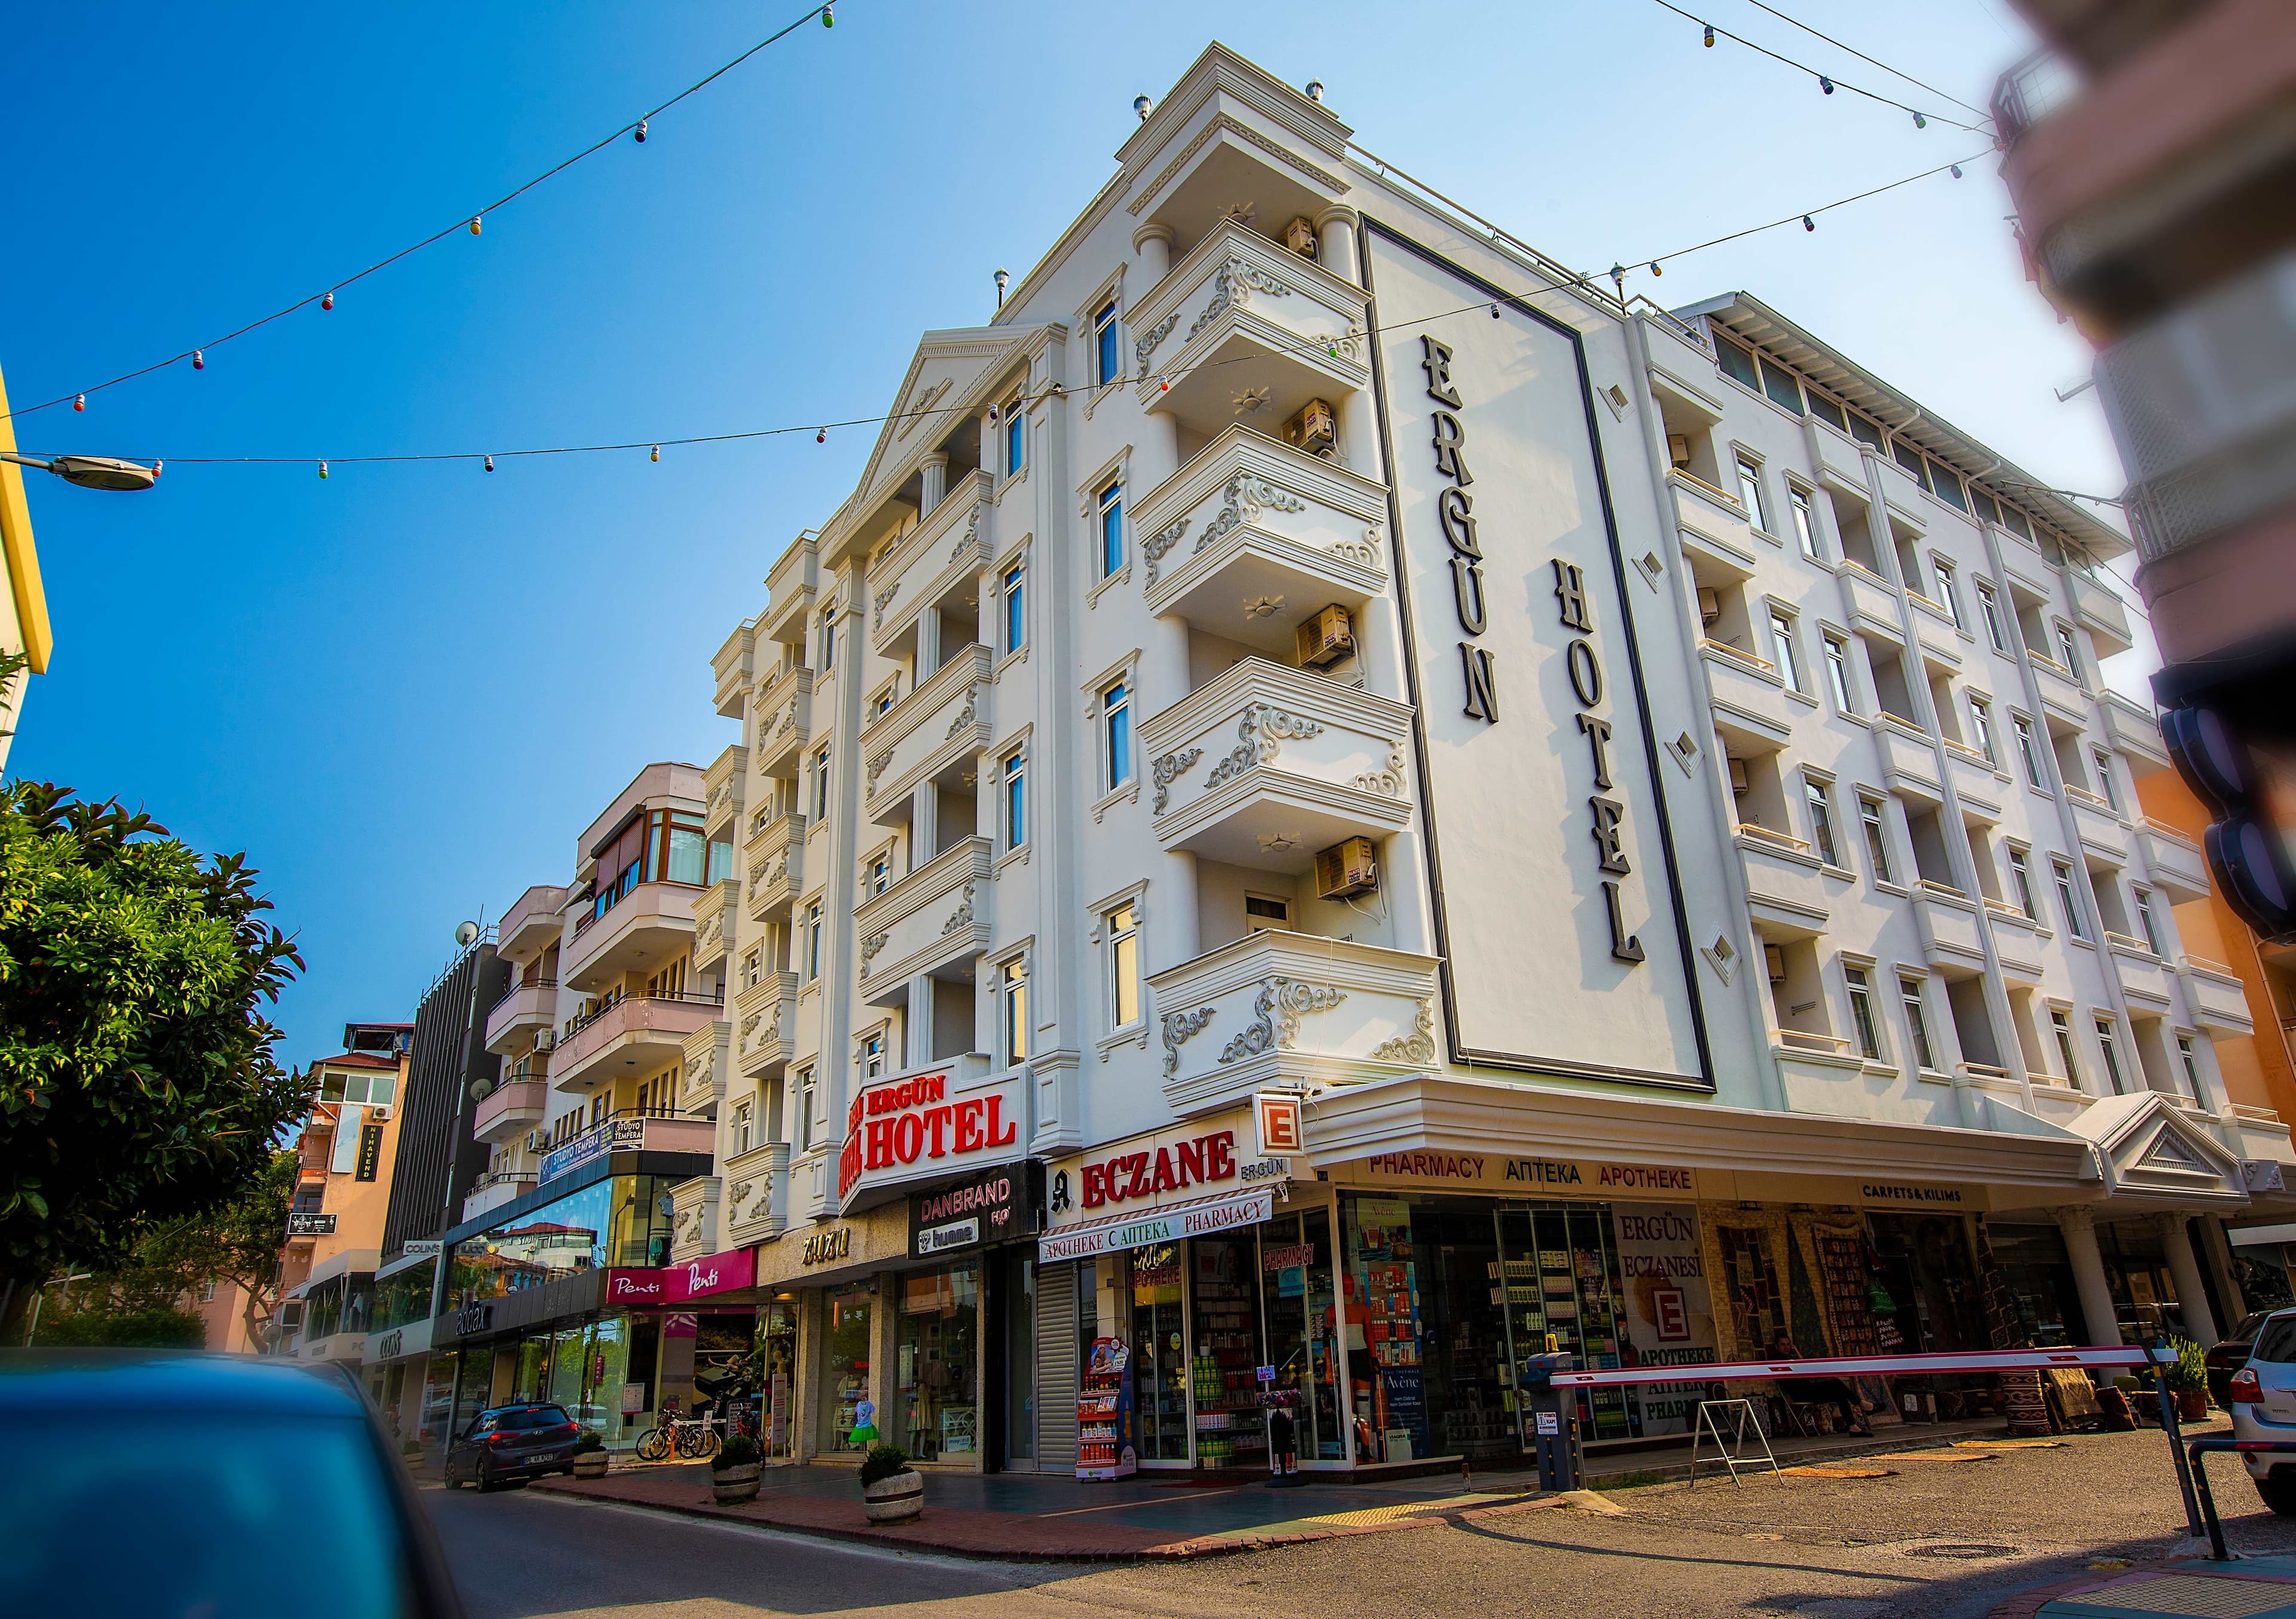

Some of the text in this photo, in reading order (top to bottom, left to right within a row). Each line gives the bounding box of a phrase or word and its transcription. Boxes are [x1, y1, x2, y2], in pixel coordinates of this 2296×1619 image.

[1421, 333, 1498, 723] ERGÜN
[1552, 558, 1645, 962] HOTEL
[867, 1075, 946, 1115] ERGÜN
[615, 1132, 642, 1141] TEMPERA
[865, 1094, 1016, 1170] HOTEL
[364, 1127, 376, 1178] NIHAVEND
[554, 1145, 574, 1166] STUDYO
[575, 1133, 599, 1157] TEMPERA
[1080, 1130, 1236, 1208] ECZANE
[1241, 1158, 1287, 1181] ERGÜN
[1370, 1154, 1485, 1179] PHARMACY
[1505, 1160, 1582, 1184] АПТЕКА
[1599, 1166, 1692, 1189] APOTHEKE
[921, 1178, 1010, 1222] DANBRAND
[1863, 1185, 1961, 1202] CARPETS & KILIMS
[1185, 1200, 1263, 1233] PHARMACY
[1619, 1211, 1694, 1240] ERGÜN
[1045, 1233, 1104, 1259] APOTHEKE
[1120, 1221, 1170, 1245] АПТЕКА
[406, 1243, 440, 1254] COLIN'S
[1264, 1243, 1314, 1272] PHARMACY
[1622, 1248, 1704, 1277] ECZANESİ
[615, 1277, 660, 1294] Penti
[688, 1263, 718, 1295] Penti
[1128, 1265, 1181, 1291] APOTHEKE
[1641, 1347, 1715, 1367] APOTHEKE
[1387, 1376, 1419, 1389] Avène
